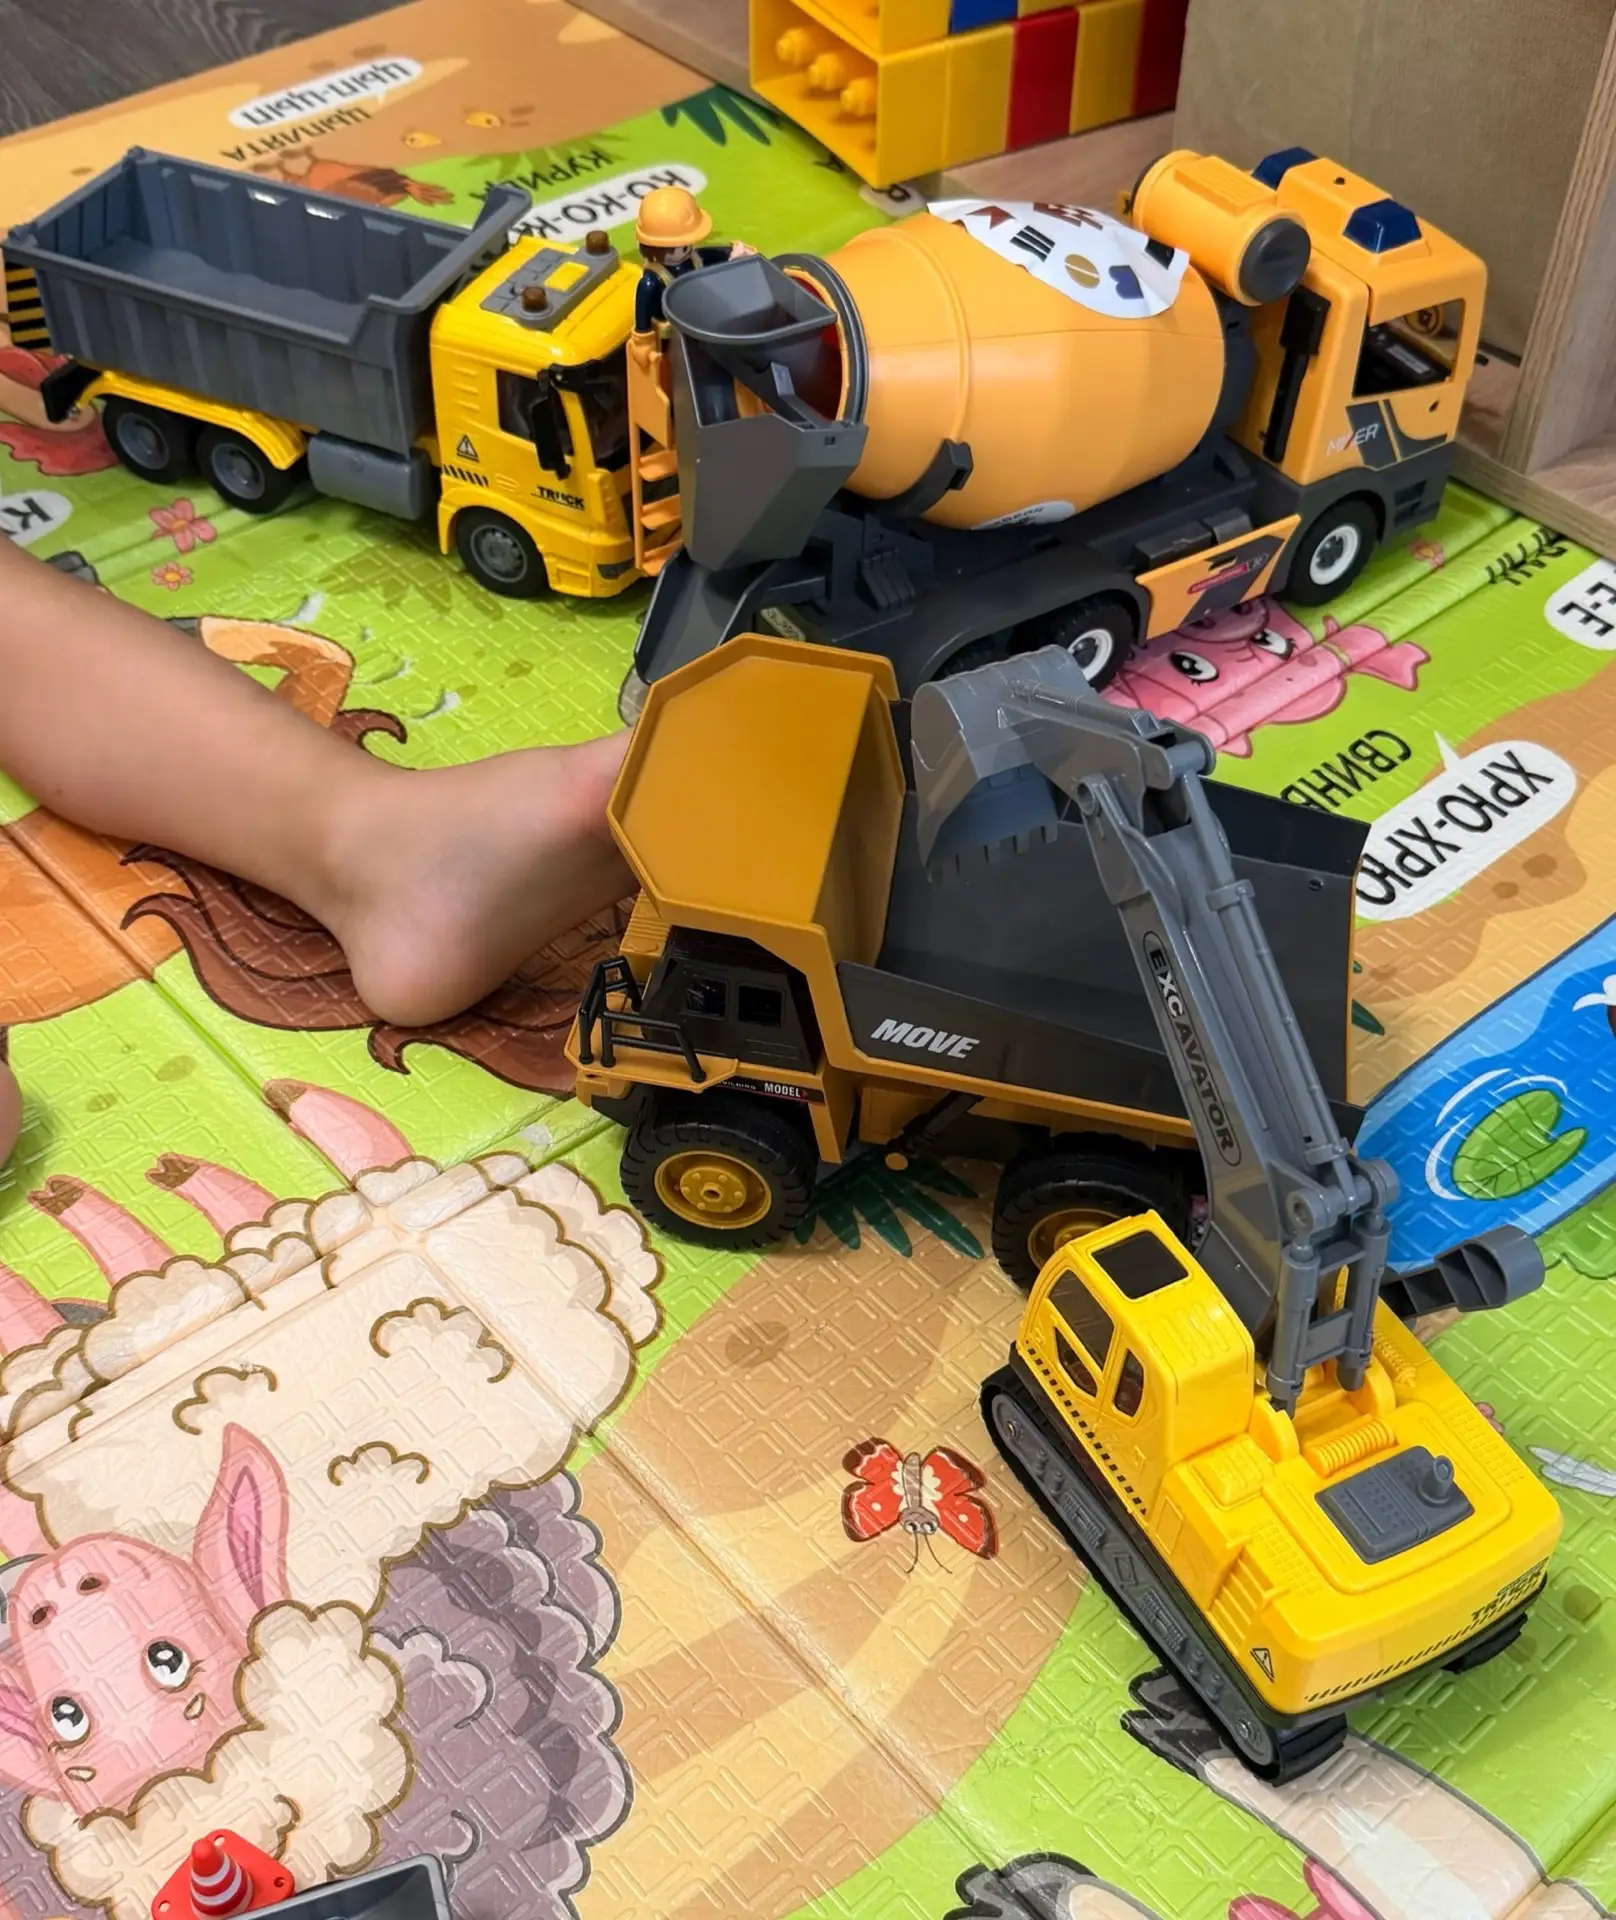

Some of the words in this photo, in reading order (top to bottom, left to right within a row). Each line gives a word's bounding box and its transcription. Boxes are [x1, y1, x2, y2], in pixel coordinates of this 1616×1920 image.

[240, 61, 412, 126] ЦЫП-ЦЫП
[219, 107, 372, 162] ЦЫПЛЯТА
[1280, 730, 1412, 814] СВИНЬ
[1356, 750, 1555, 906] ХРЮ-ХРЮ
[870, 1018, 981, 1059] MOVE
[1149, 948, 1235, 1151] EXCAVATOR
[764, 1081, 802, 1098] MODEL
